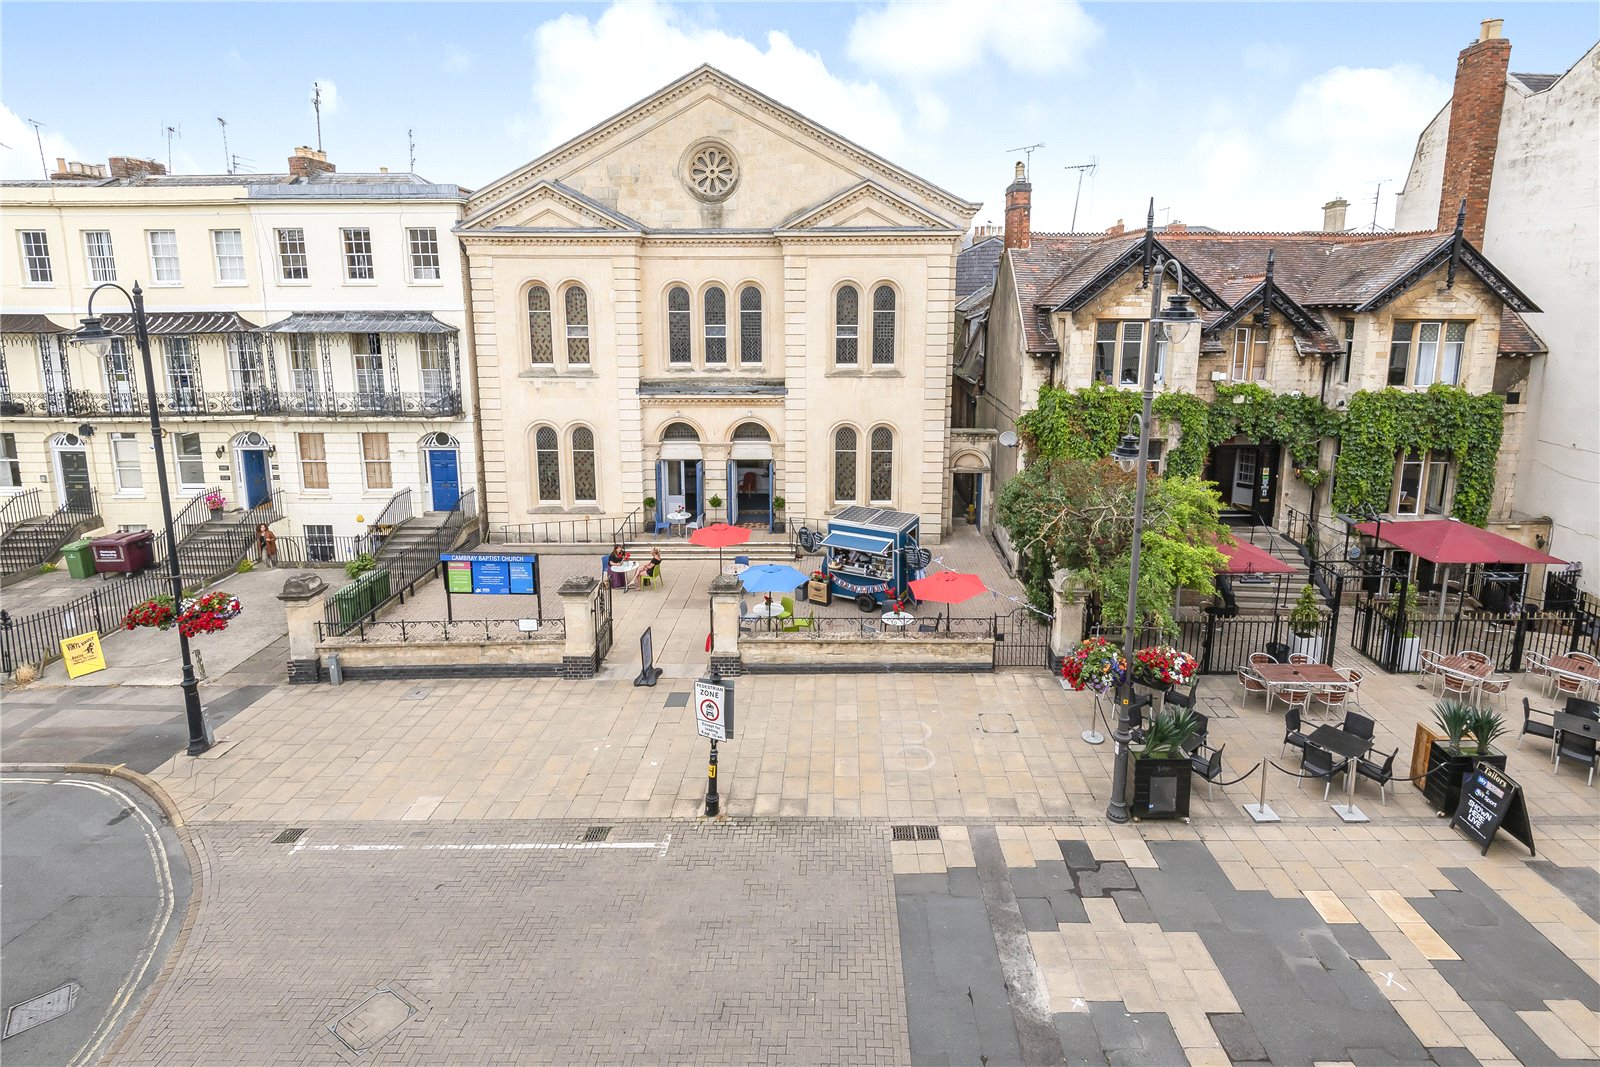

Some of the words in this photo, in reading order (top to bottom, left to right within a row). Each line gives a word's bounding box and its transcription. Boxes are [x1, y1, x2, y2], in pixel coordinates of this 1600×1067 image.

[696, 683, 724, 692] PEDESTRIAN
[700, 689, 719, 698] ZONE
[1478, 776, 1488, 787] sky
[1484, 767, 1507, 787] Tailors
[1483, 794, 1498, 808] Sport
[1468, 799, 1492, 821] SHOWN
[1469, 807, 1486, 825] HERE
[1467, 814, 1482, 829] LIVE
